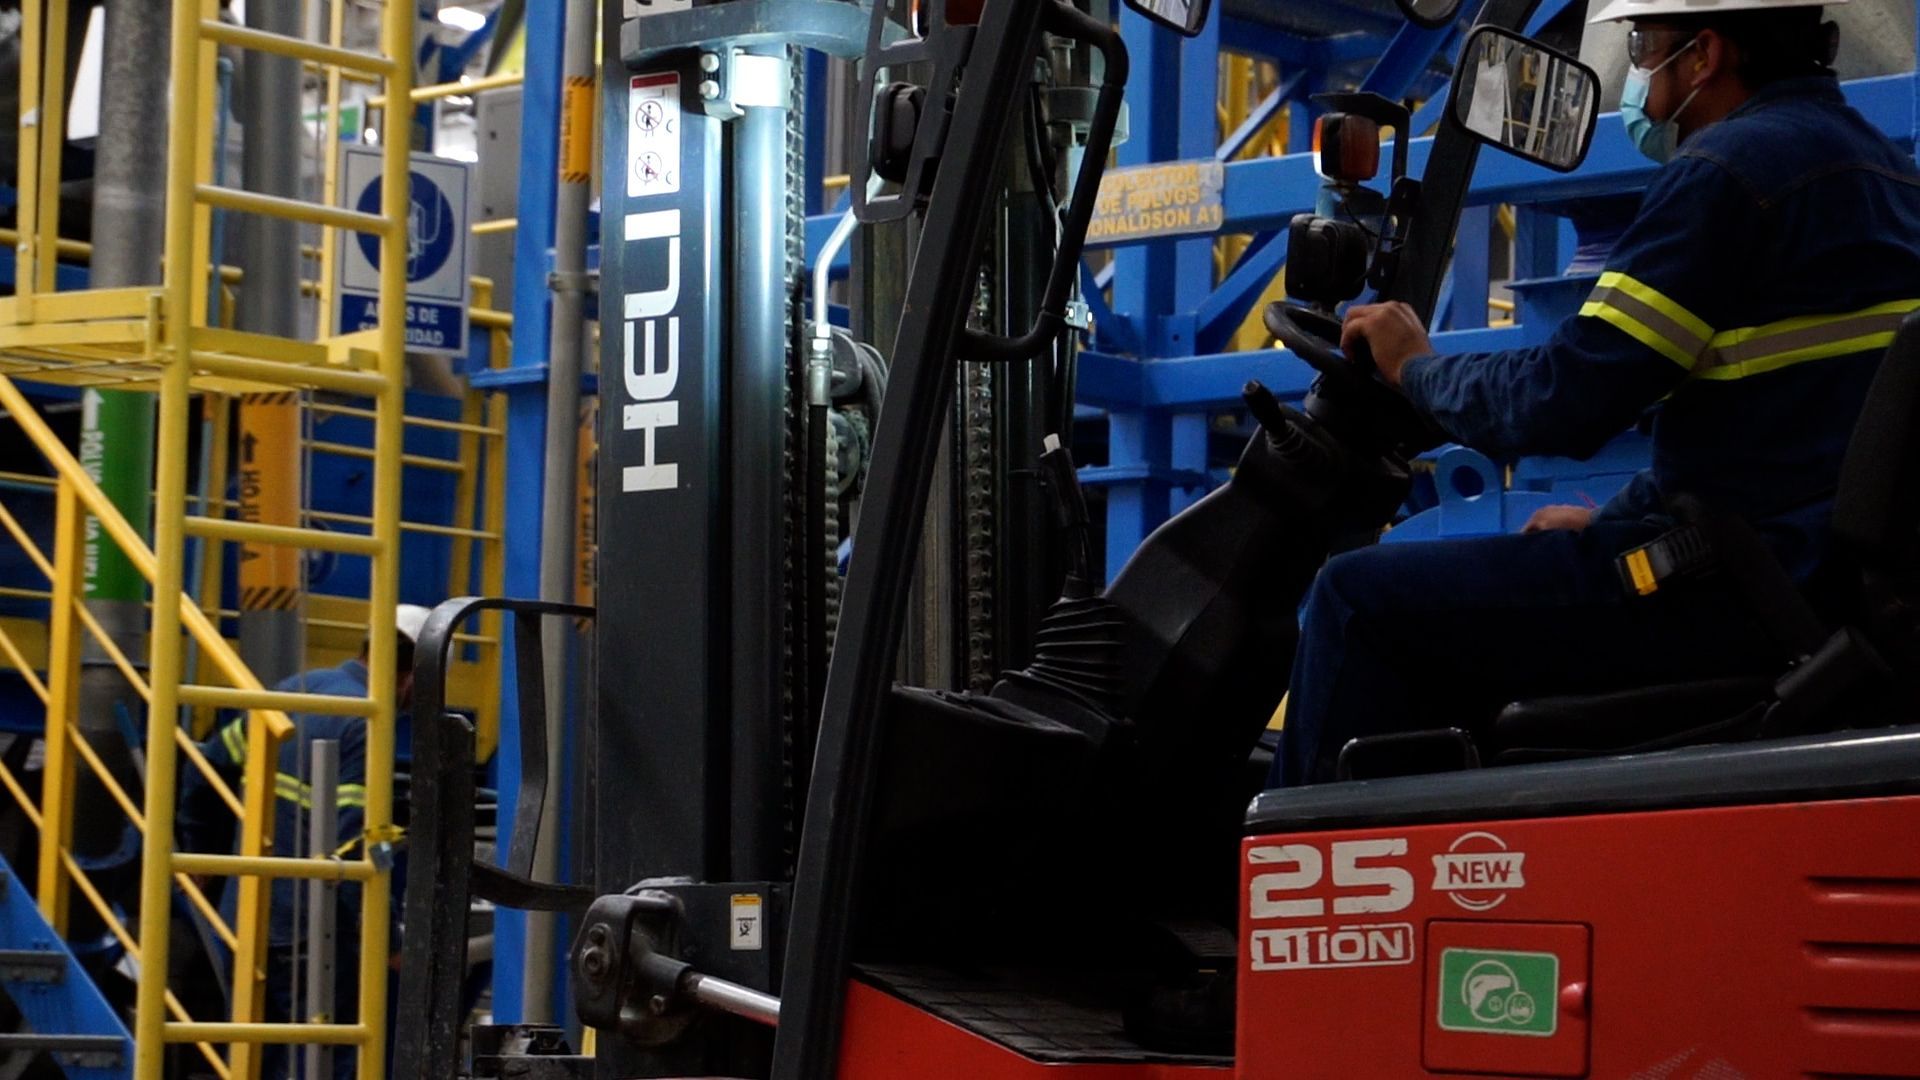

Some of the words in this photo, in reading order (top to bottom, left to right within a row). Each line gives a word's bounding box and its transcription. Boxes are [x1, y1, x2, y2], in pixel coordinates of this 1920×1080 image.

[1088, 208, 1190, 237] ONALDSON
[623, 209, 680, 492] HELI
[1248, 838, 1414, 918] 25
[1448, 861, 1512, 884] NEW
